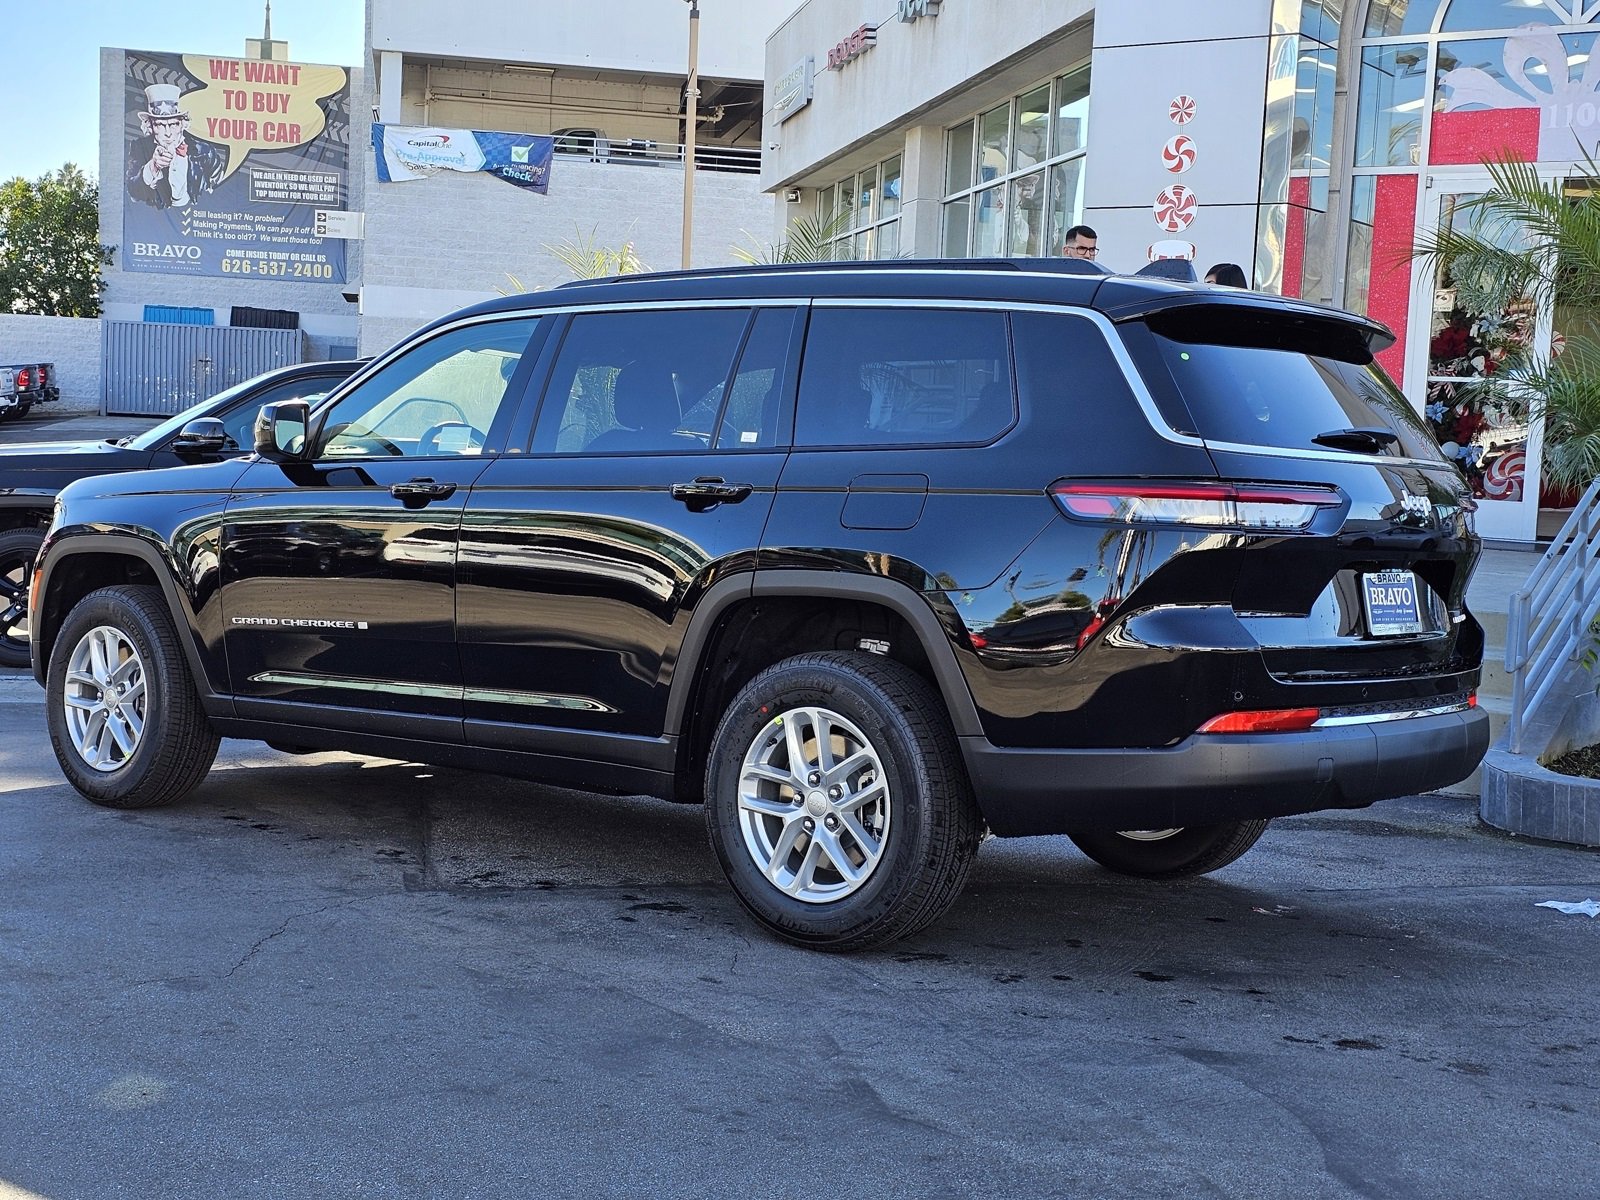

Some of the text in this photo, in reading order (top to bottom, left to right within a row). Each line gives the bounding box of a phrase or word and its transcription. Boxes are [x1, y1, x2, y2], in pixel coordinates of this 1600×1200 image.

[828, 23, 872, 71] DODGE
[209, 59, 301, 86] WE WANT
[223, 90, 291, 114] TO BUY
[1546, 102, 1600, 129] 110
[206, 118, 301, 144] YOUR CAR
[502, 167, 534, 182] Check.
[289, 182, 298, 190] SO
[268, 190, 289, 198] MONEY
[302, 192, 318, 200] YOUR
[208, 212, 232, 221] leasing
[254, 214, 284, 223] problem!
[193, 220, 218, 230] Making
[219, 222, 254, 232] Payments,
[256, 224, 266, 232] We
[280, 226, 294, 234] pay
[193, 230, 212, 238] Think
[132, 242, 202, 259] BRAVO
[226, 249, 326, 262] COME INSIDE TODAY OR CALL US
[222, 258, 332, 278] 626-537-2400
[1401, 490, 1431, 516] Jeep
[1376, 574, 1401, 582] BRAVO
[1370, 588, 1411, 606] BRAVO
[232, 617, 279, 625] GRAND
[281, 618, 354, 628] CHEROKEE
